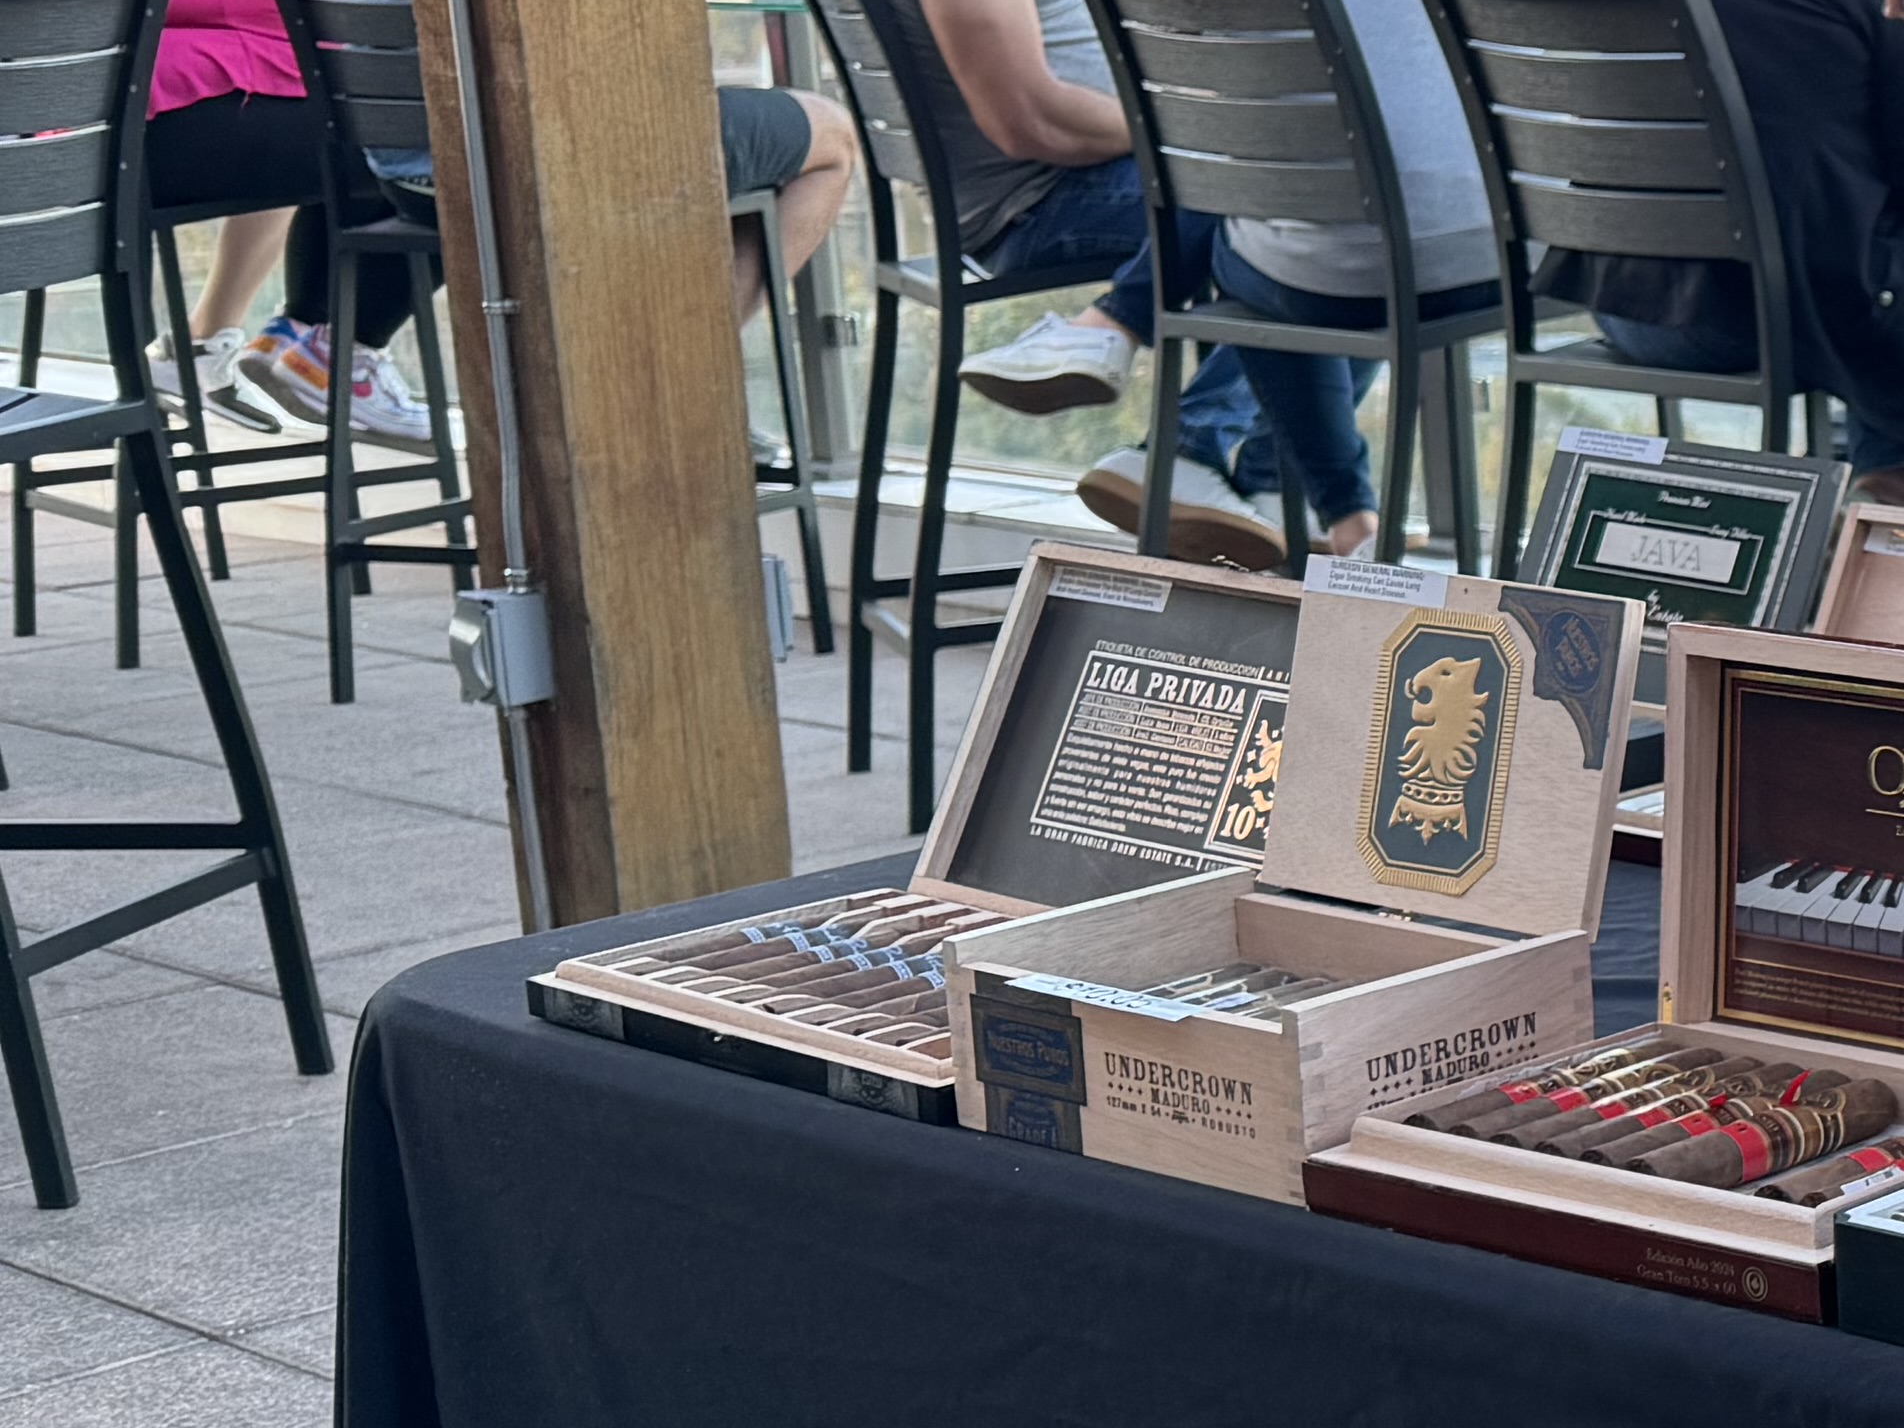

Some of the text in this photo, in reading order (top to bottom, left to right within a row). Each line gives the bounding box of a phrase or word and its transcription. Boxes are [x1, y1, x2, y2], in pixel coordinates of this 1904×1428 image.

[1631, 535, 1701, 572] JAVA
[1148, 648, 1187, 666] CONTROL
[1086, 662, 1247, 714] LIGA PRIVADA
[1221, 803, 1255, 841] 10
[1030, 825, 1041, 836] LA
[1044, 827, 1068, 843] GRAN
[1071, 832, 1108, 850] FABRICA
[1110, 839, 1138, 857] DREW
[1366, 1012, 1536, 1082] UNDERCROWN
[1104, 1052, 1253, 1105] UNDERCROWN
[1422, 1051, 1490, 1085] MADURO
[1150, 1087, 1210, 1115] MADURO
[1201, 1116, 1256, 1139] ROBUSTO
